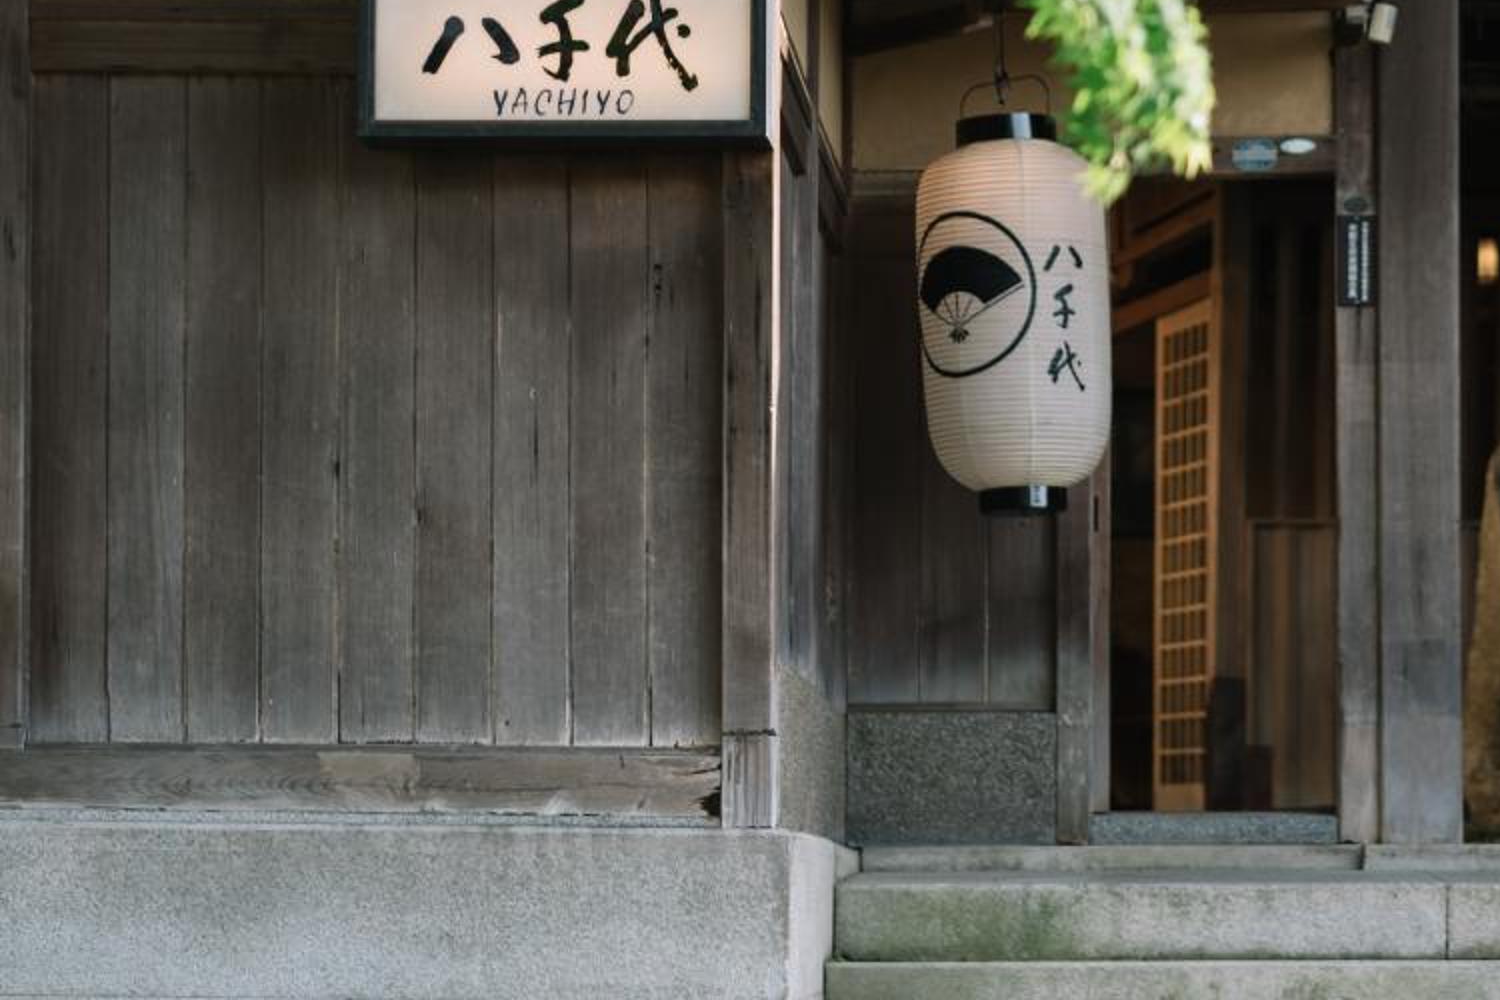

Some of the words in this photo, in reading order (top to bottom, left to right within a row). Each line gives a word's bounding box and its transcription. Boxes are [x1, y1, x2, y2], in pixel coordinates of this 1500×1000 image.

[493, 88, 636, 116] YACHIYO
[1043, 244, 1086, 392] 八千代
